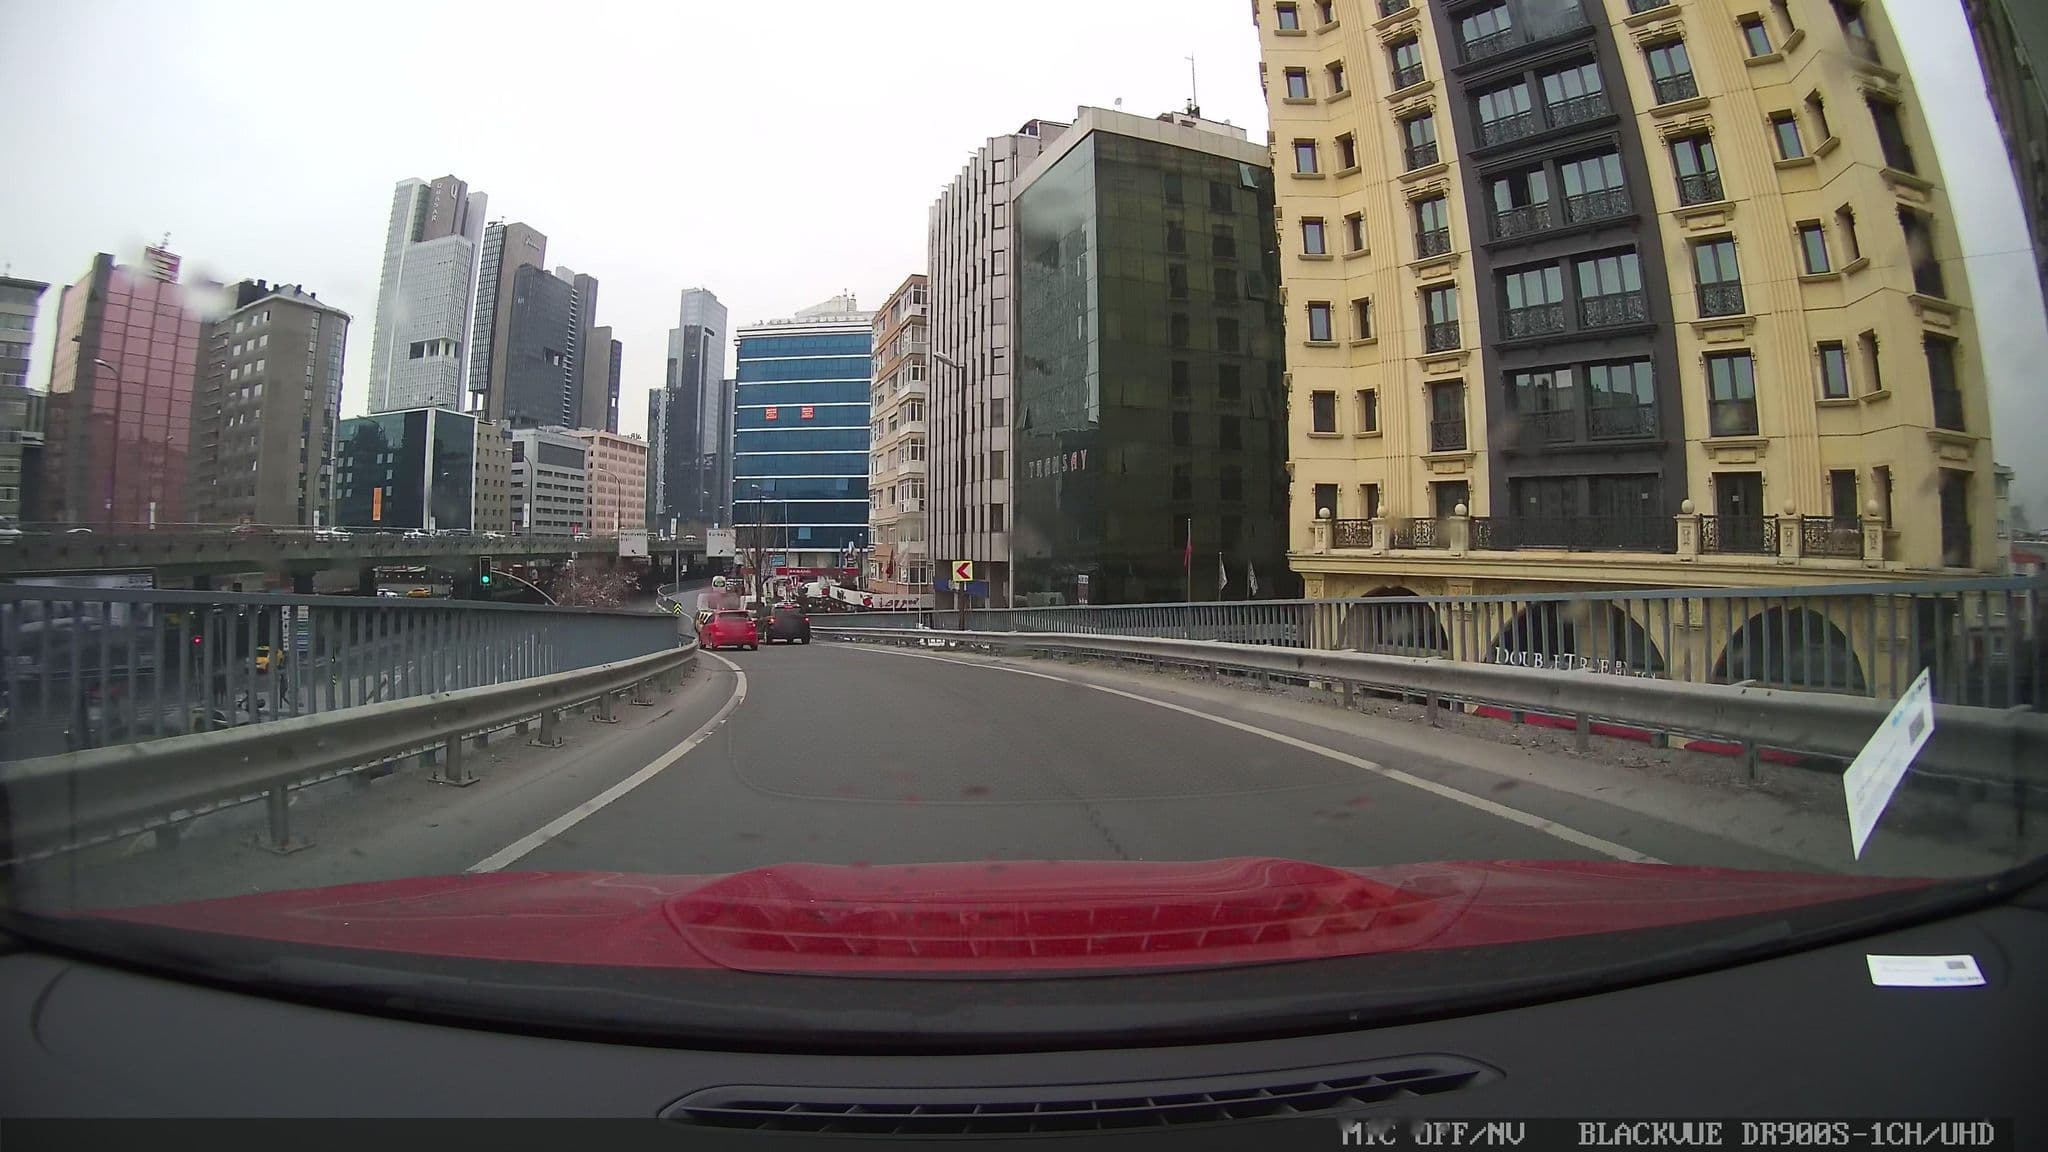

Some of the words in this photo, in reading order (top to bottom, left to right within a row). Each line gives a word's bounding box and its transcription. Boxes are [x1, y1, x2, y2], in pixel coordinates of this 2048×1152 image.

[450, 183, 457, 199] Q
[1029, 449, 1087, 478] TRANSAY
[1495, 647, 1610, 674] DOUBETRE
